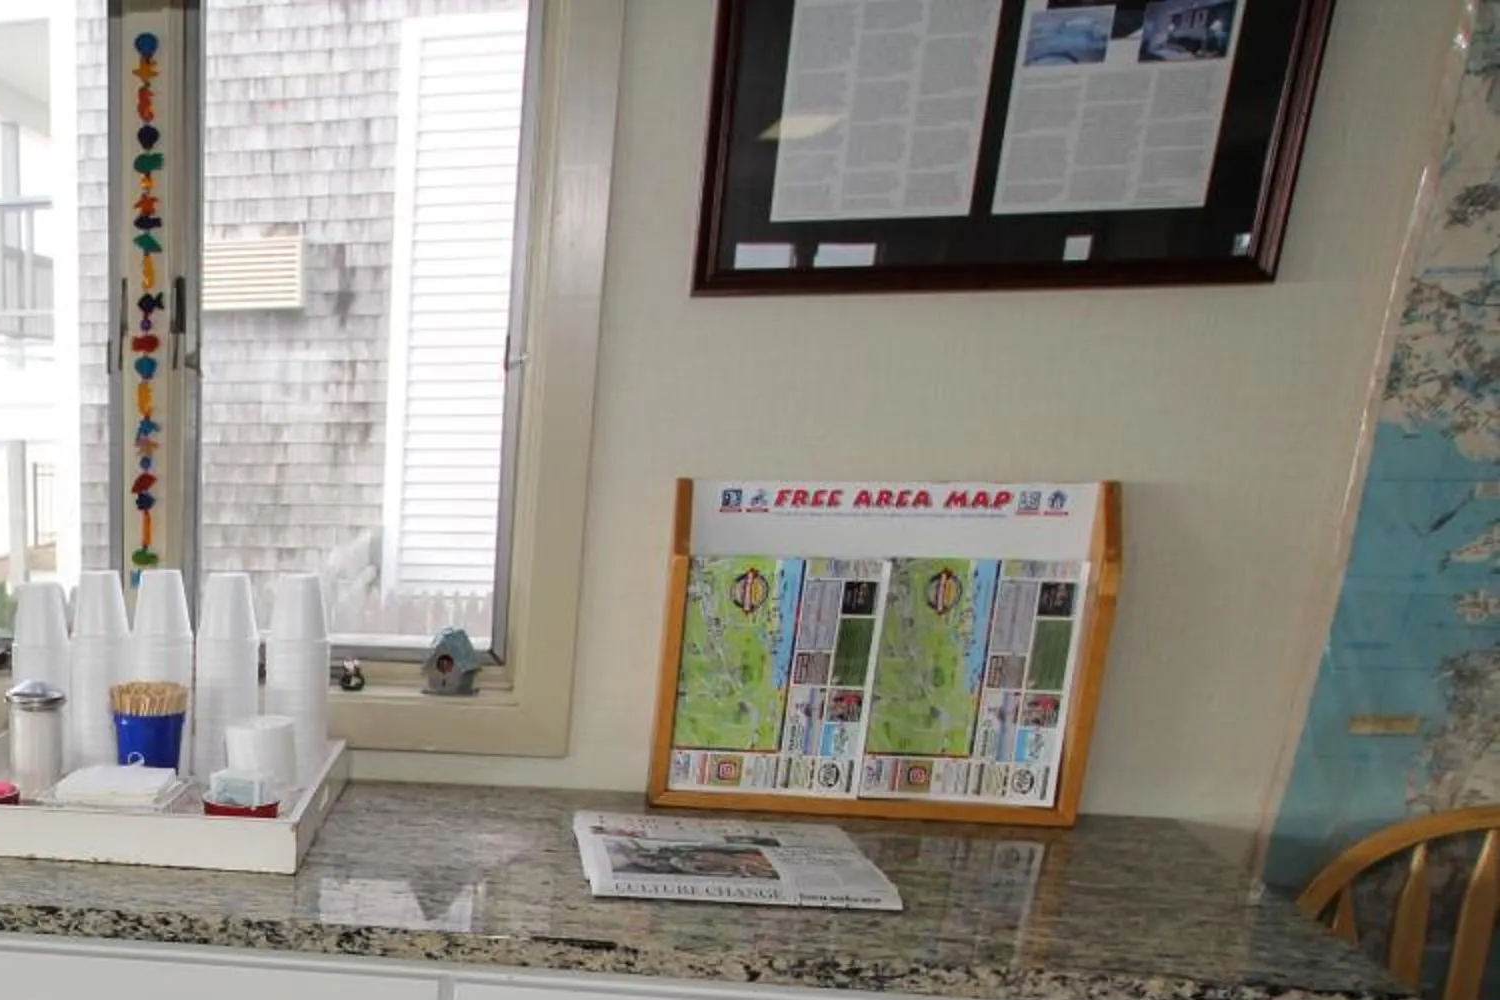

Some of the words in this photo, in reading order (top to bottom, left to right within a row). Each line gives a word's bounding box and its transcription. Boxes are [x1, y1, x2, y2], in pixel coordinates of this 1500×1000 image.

[774, 489, 844, 508] FREE
[852, 489, 933, 509] AREA
[943, 490, 1013, 510] MAP
[614, 882, 697, 897] CULTURE
[705, 886, 781, 901] CHANGE
